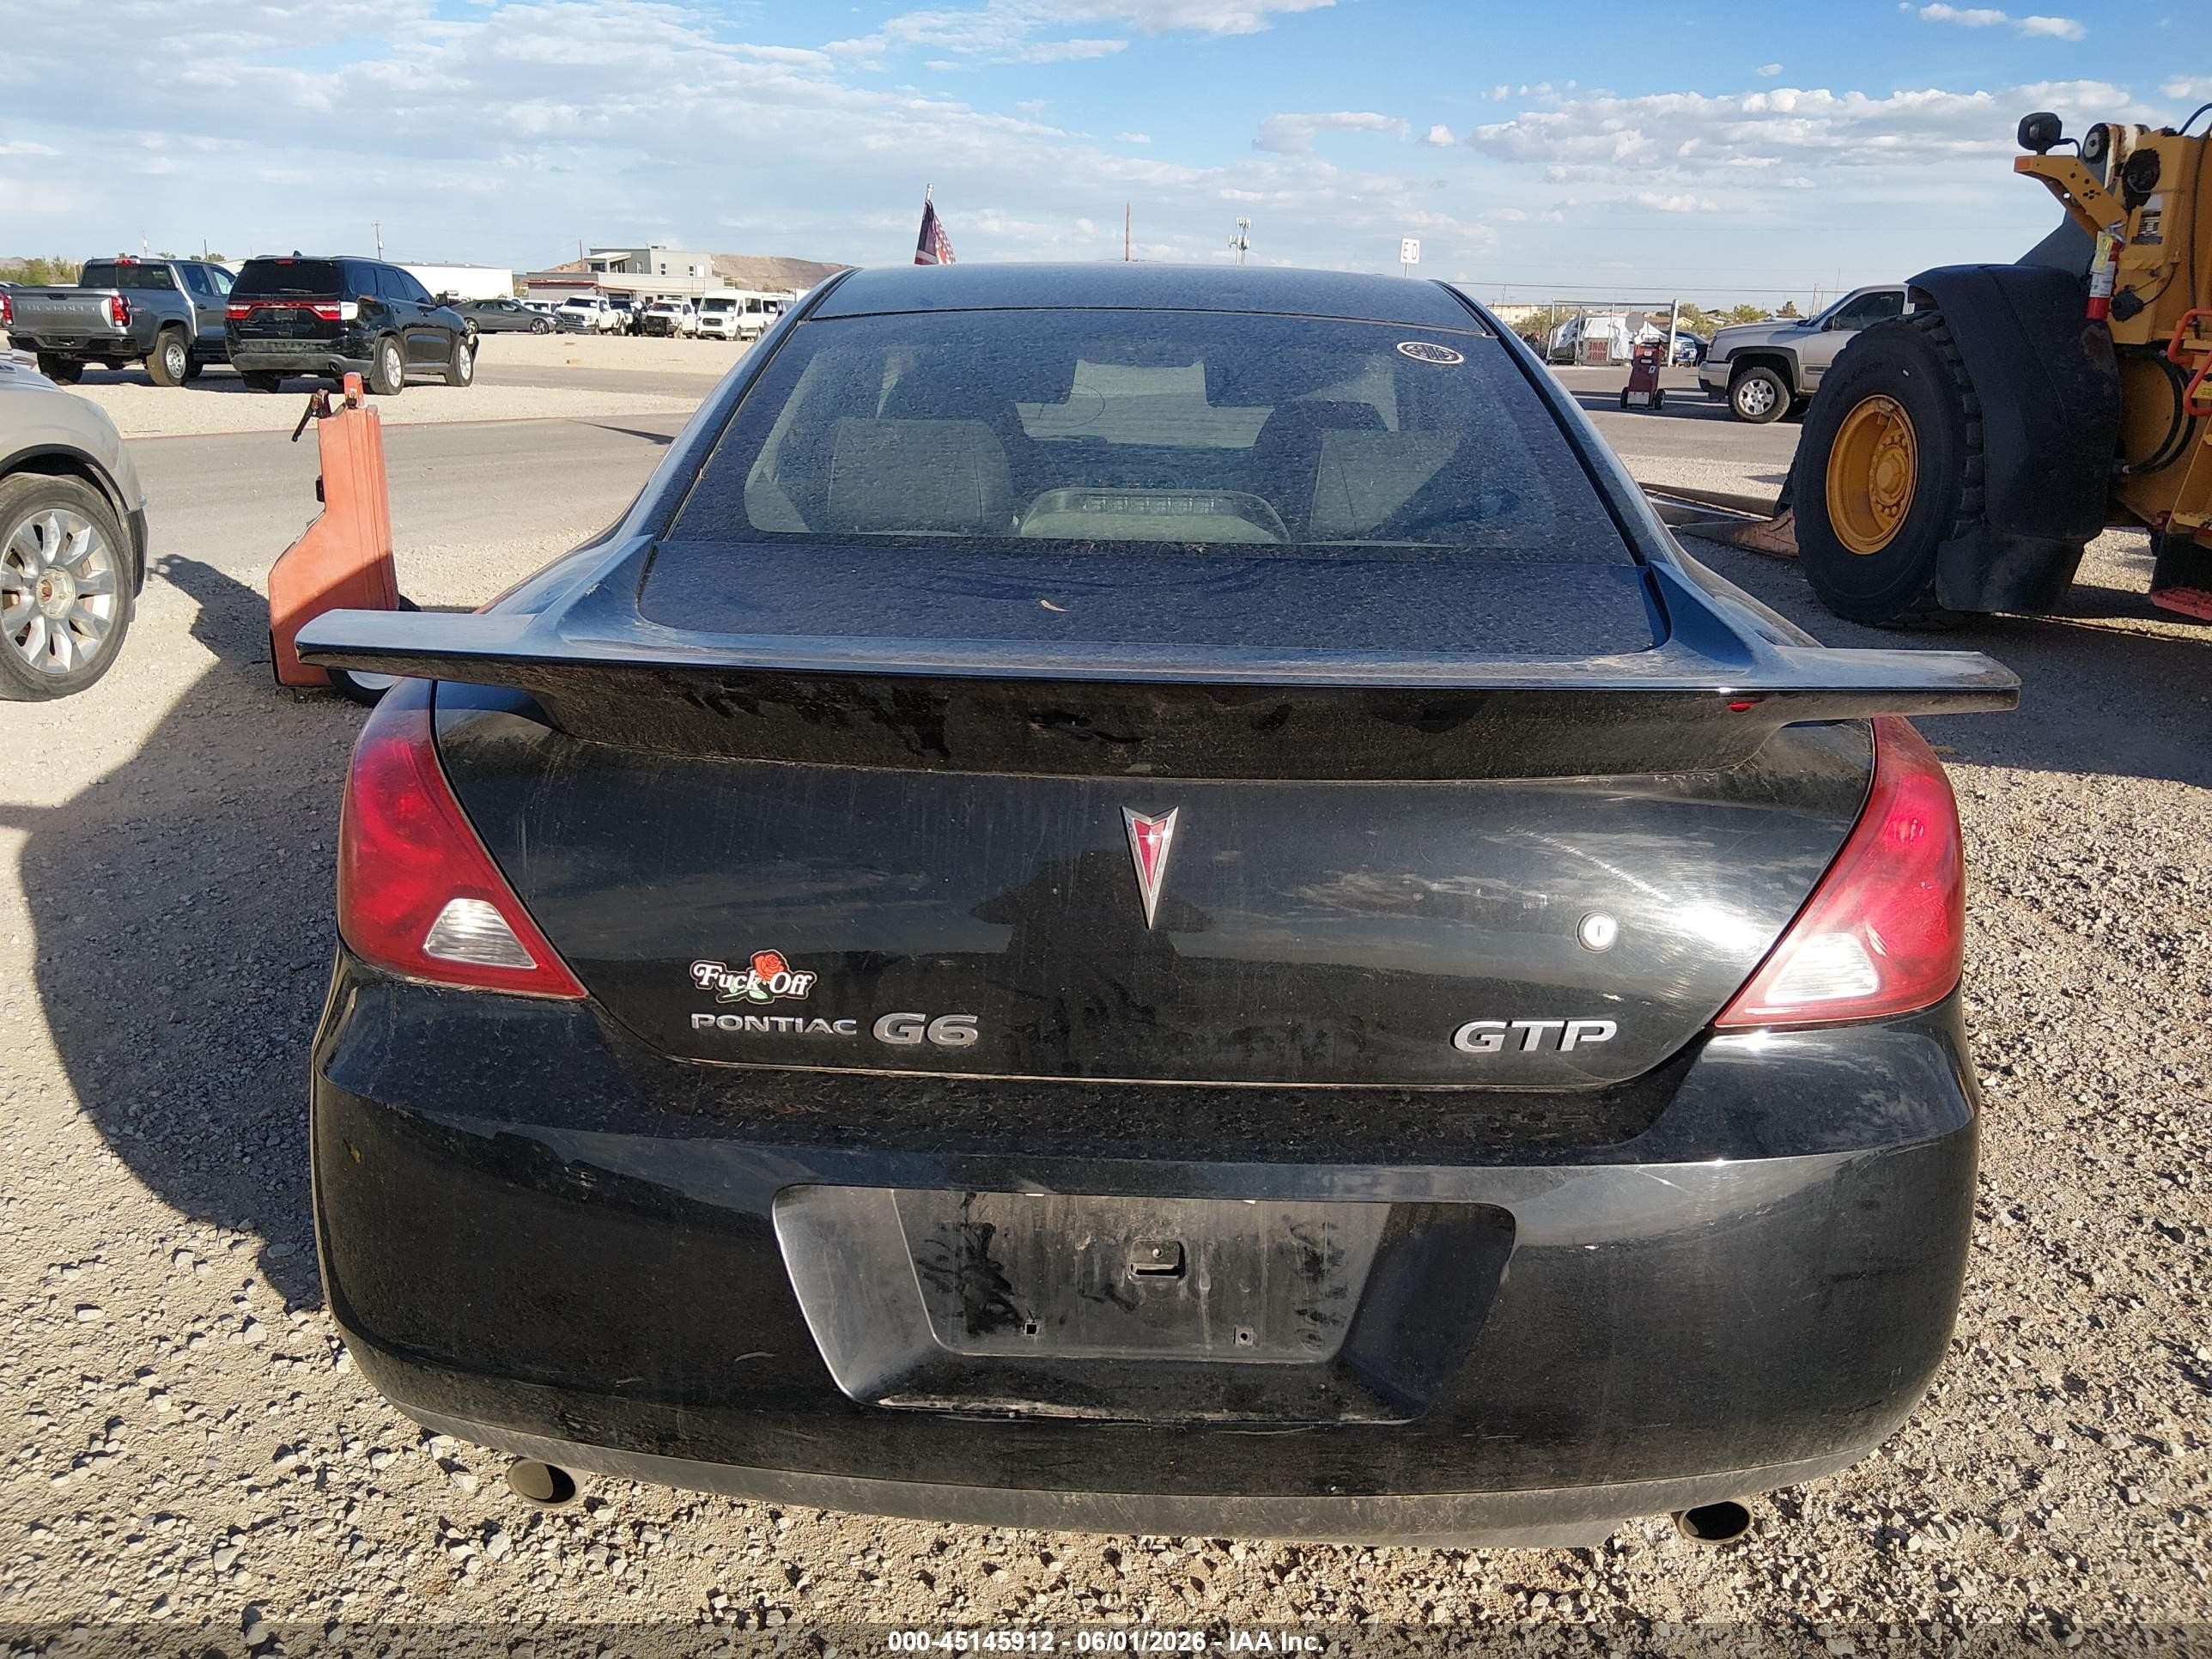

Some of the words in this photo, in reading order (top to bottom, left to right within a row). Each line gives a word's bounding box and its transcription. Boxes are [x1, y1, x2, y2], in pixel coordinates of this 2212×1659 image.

[1589, 342, 1608, 351] ZONE
[693, 963, 759, 990] Fuck
[769, 971, 812, 995] Off
[690, 1013, 857, 1036] PONTIAC
[873, 1012, 978, 1046] G6
[1450, 1020, 1617, 1052] GTP
